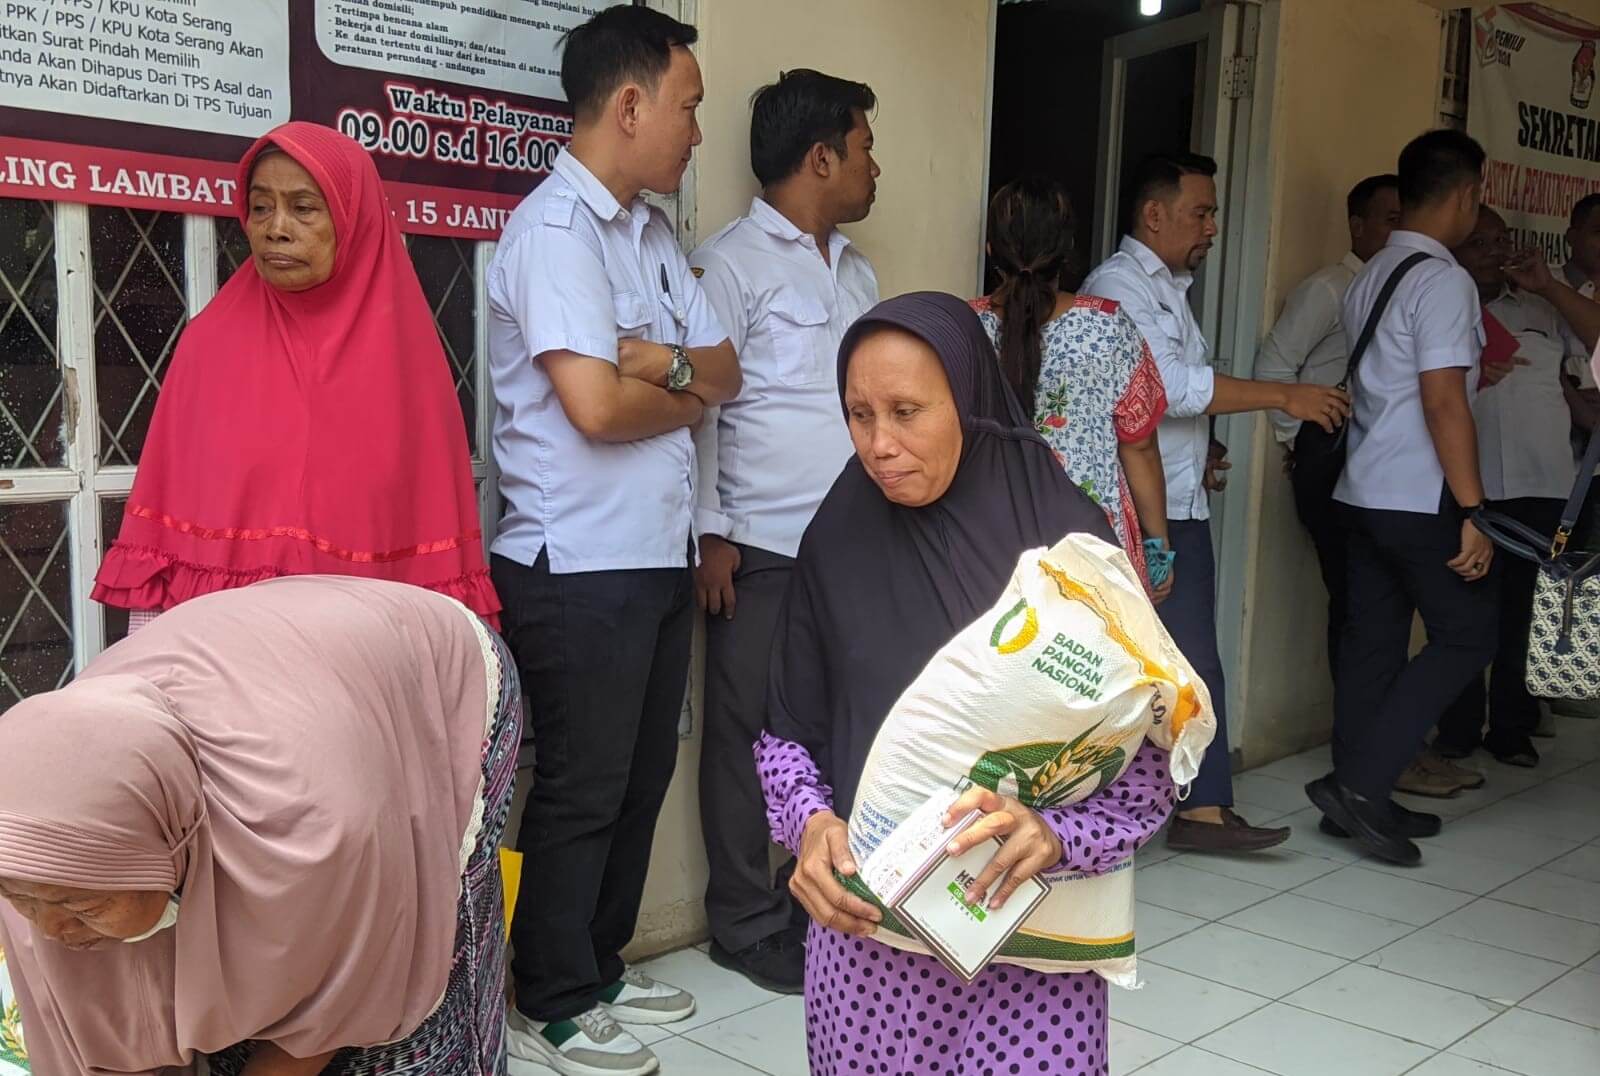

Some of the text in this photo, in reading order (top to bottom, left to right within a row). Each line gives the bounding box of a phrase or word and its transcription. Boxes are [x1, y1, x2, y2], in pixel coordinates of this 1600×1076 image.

[6, 3, 263, 59] PPK / PPS / KPU Kota Serang Akan
[110, 0, 140, 17] KPU
[145, 6, 178, 24] Kota
[182, 12, 232, 36] Serang
[334, 4, 449, 33] Tertimpa bencana alam
[460, 5, 508, 21] pendidikan
[509, 15, 551, 30] menengah
[42, 31, 84, 51] Surat
[89, 38, 140, 59] Pindah
[145, 47, 200, 69] Memilih
[335, 17, 372, 32] Bekerja
[375, 24, 385, 34] di
[388, 26, 407, 37] luar
[469, 41, 506, 56] dan/atau
[0, 48, 272, 100] nda Akan Dihapus Dari TPS Asal dan
[335, 44, 384, 58] peraturan
[386, 52, 437, 69] perundang
[445, 61, 486, 76] undangan
[380, 38, 421, 53] tertentu
[424, 45, 433, 54] di
[435, 46, 453, 58] luar
[455, 49, 473, 62] dari
[474, 53, 516, 71] ketentuan
[518, 62, 527, 71] di
[528, 65, 546, 75] atas
[39, 74, 78, 93] Akan
[83, 80, 169, 106] Didaftarkan
[174, 93, 189, 108] Di
[193, 96, 222, 113] TPS
[225, 100, 272, 120] Tujuan
[389, 87, 465, 119] Waktu
[340, 112, 559, 171] 09.00 s.d 16.00
[0, 156, 237, 205] ING LAMBAT
[406, 199, 438, 225] 15
[1042, 645, 1103, 685] PANGAN
[1053, 632, 1103, 666] BADAN
